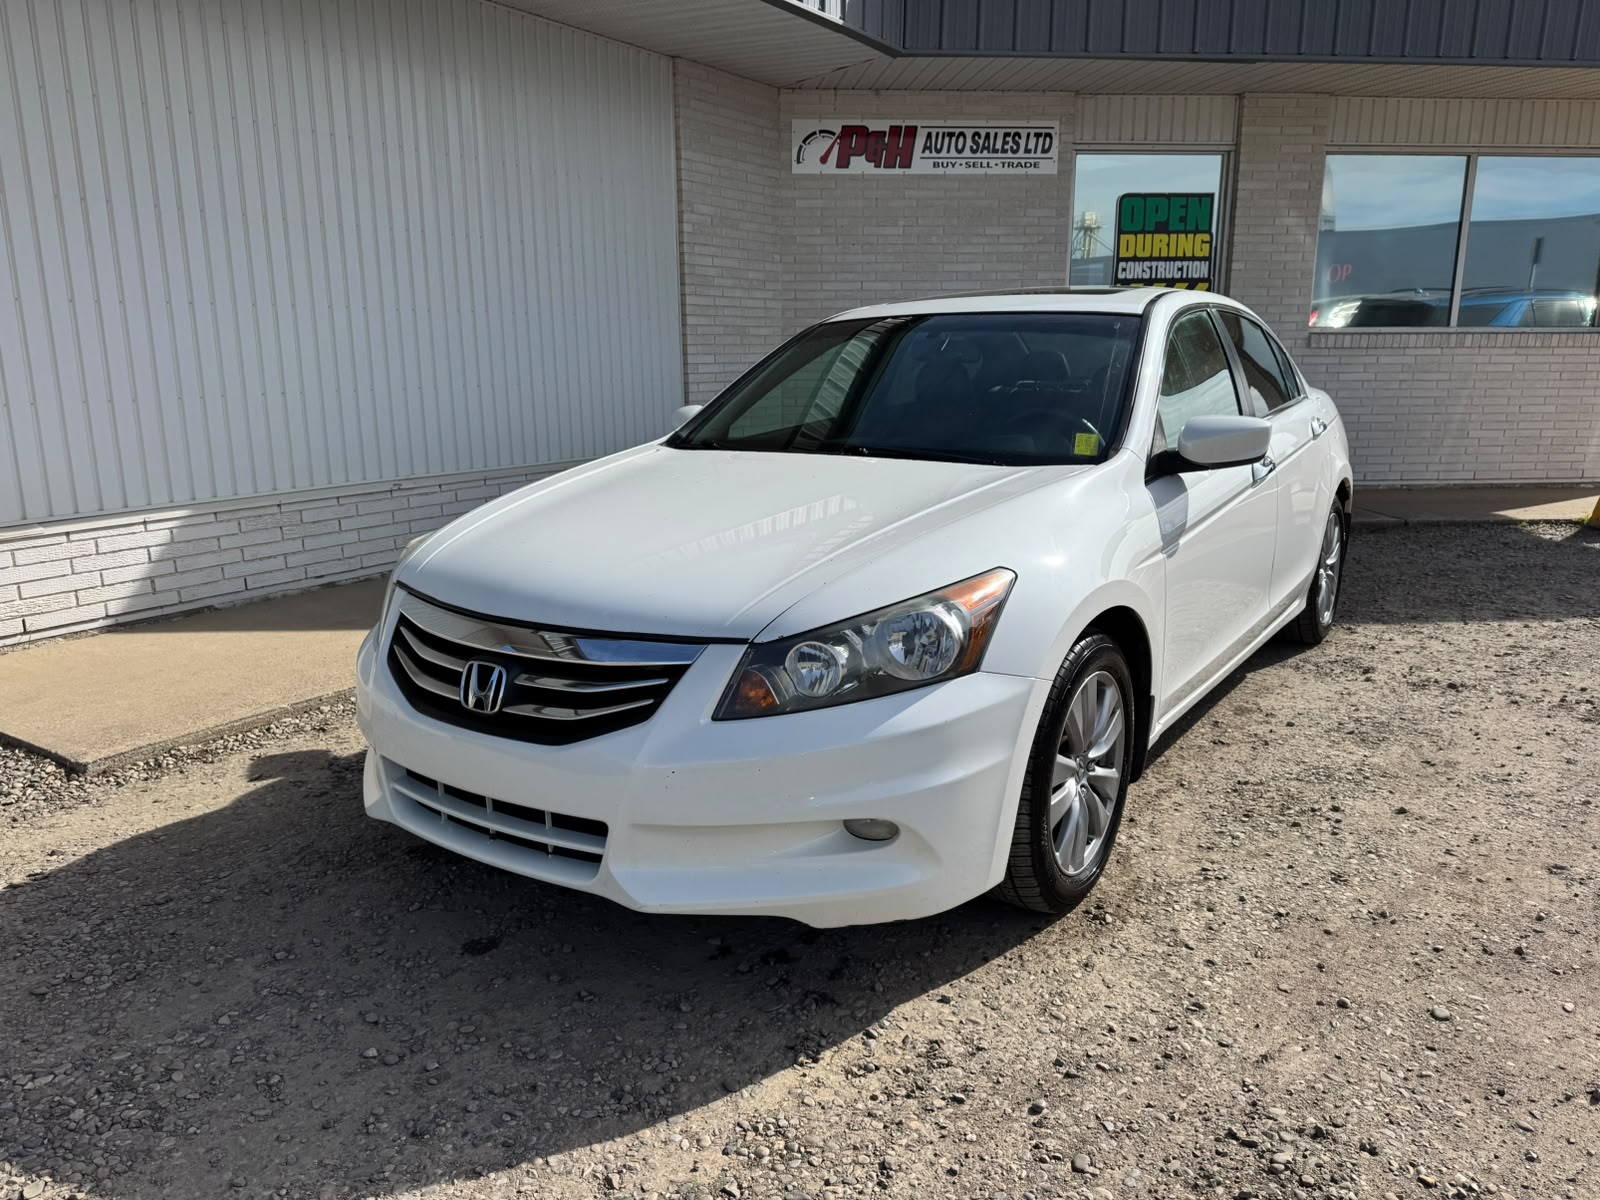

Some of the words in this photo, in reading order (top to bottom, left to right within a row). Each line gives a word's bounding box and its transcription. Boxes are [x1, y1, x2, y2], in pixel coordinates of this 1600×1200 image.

[921, 131, 967, 154] AUTO
[969, 131, 1022, 154] SALES
[1023, 131, 1054, 154] LTD
[1121, 197, 1211, 231] OPEN
[1119, 233, 1211, 258] DURING
[1117, 260, 1209, 279] CONSTRUCTION
